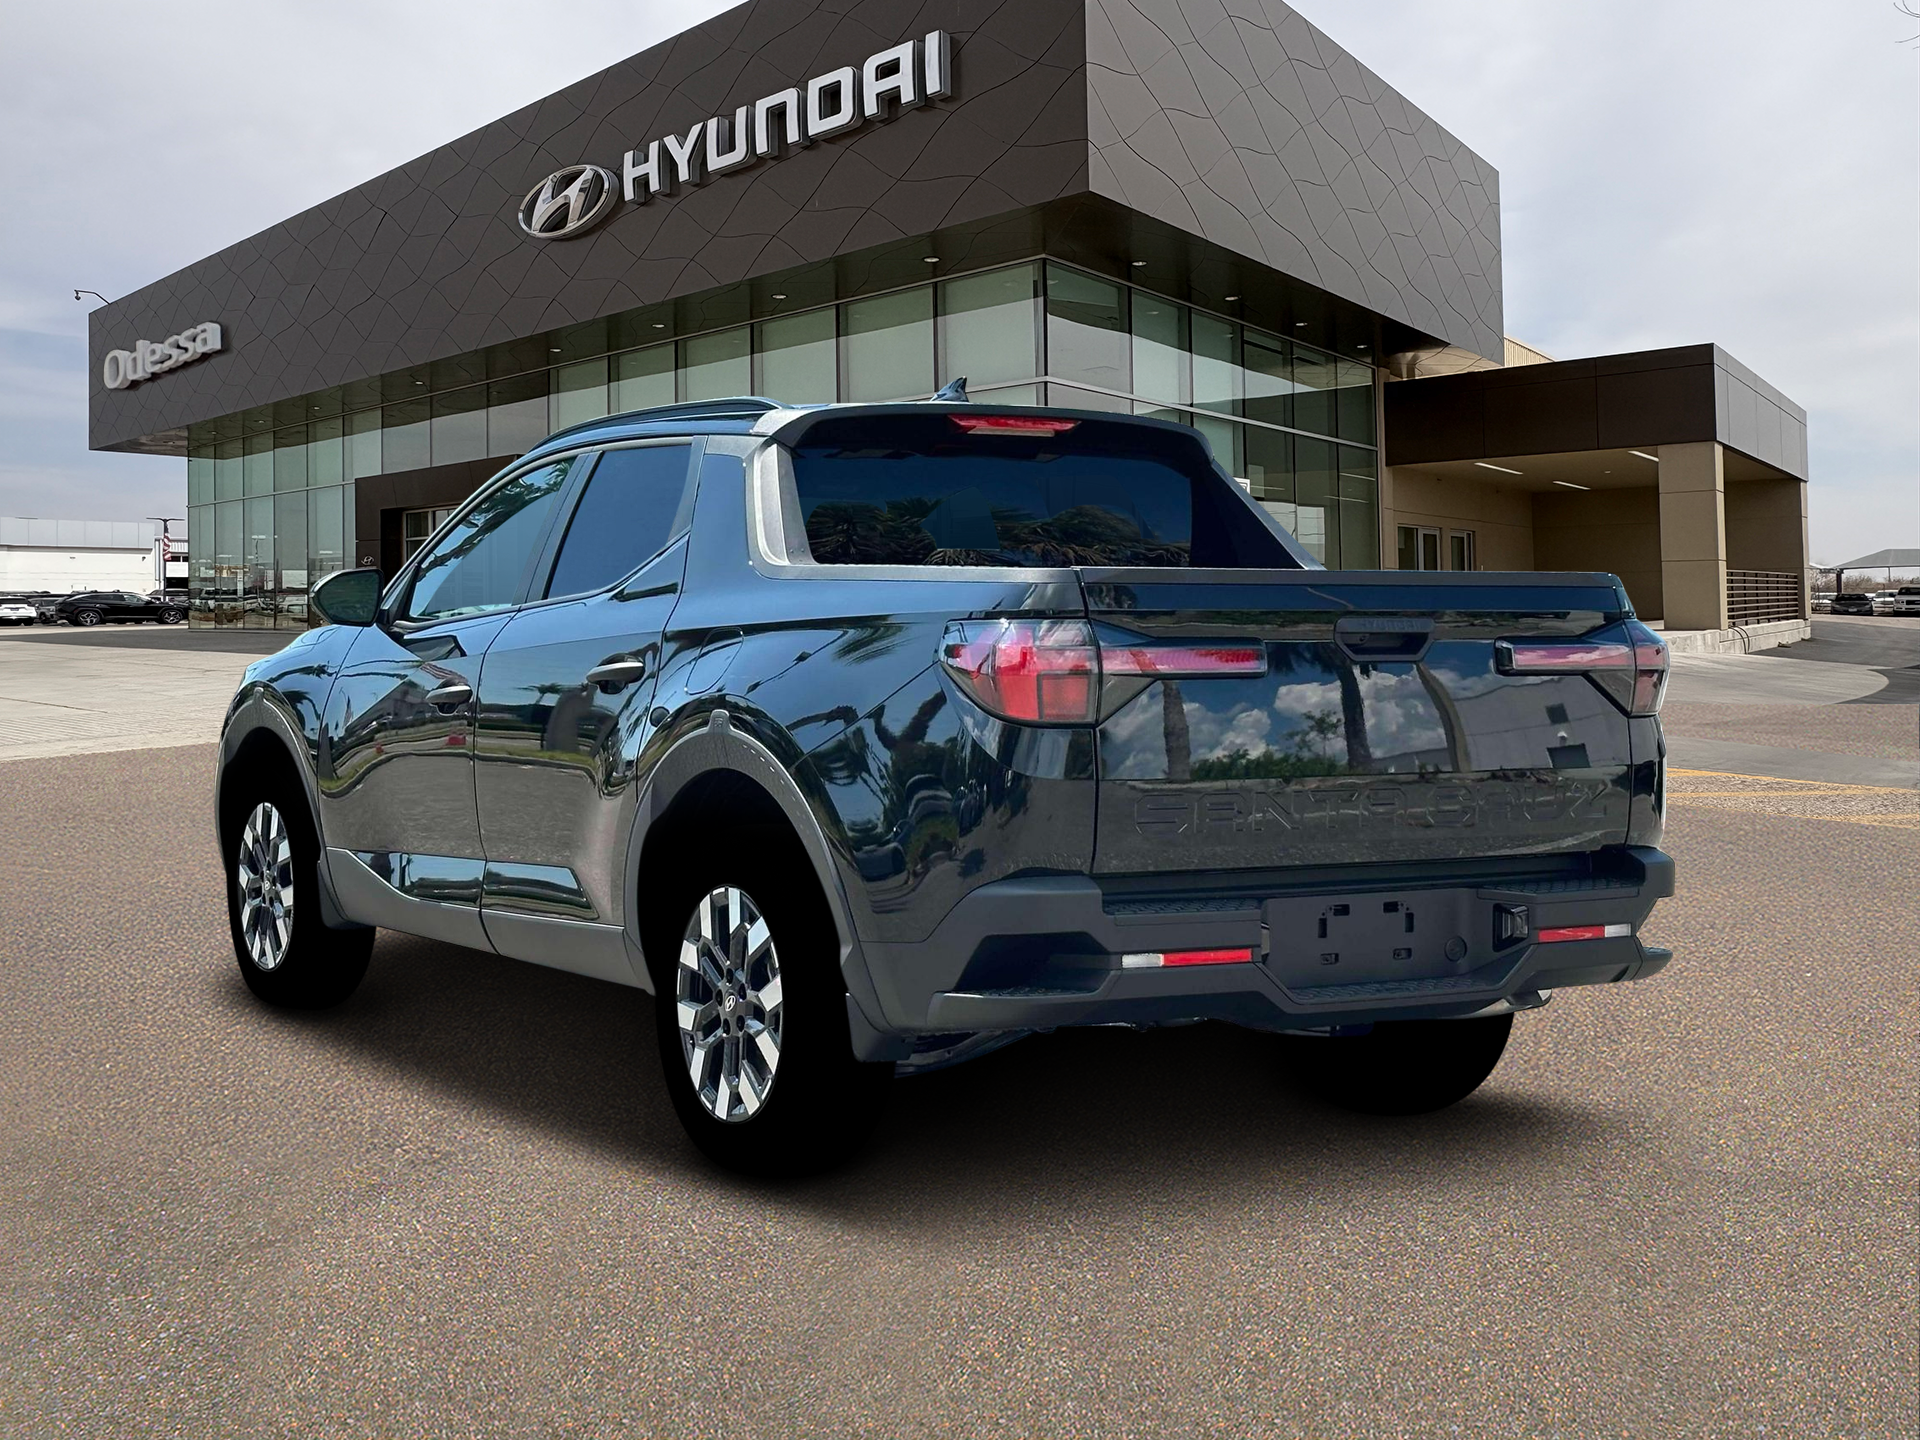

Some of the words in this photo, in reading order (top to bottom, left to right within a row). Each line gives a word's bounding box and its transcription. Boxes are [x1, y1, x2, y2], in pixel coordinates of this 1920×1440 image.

[623, 29, 950, 203] HYUNDAI
[104, 322, 221, 389] Odessa
[1135, 788, 1408, 834] SANTA
